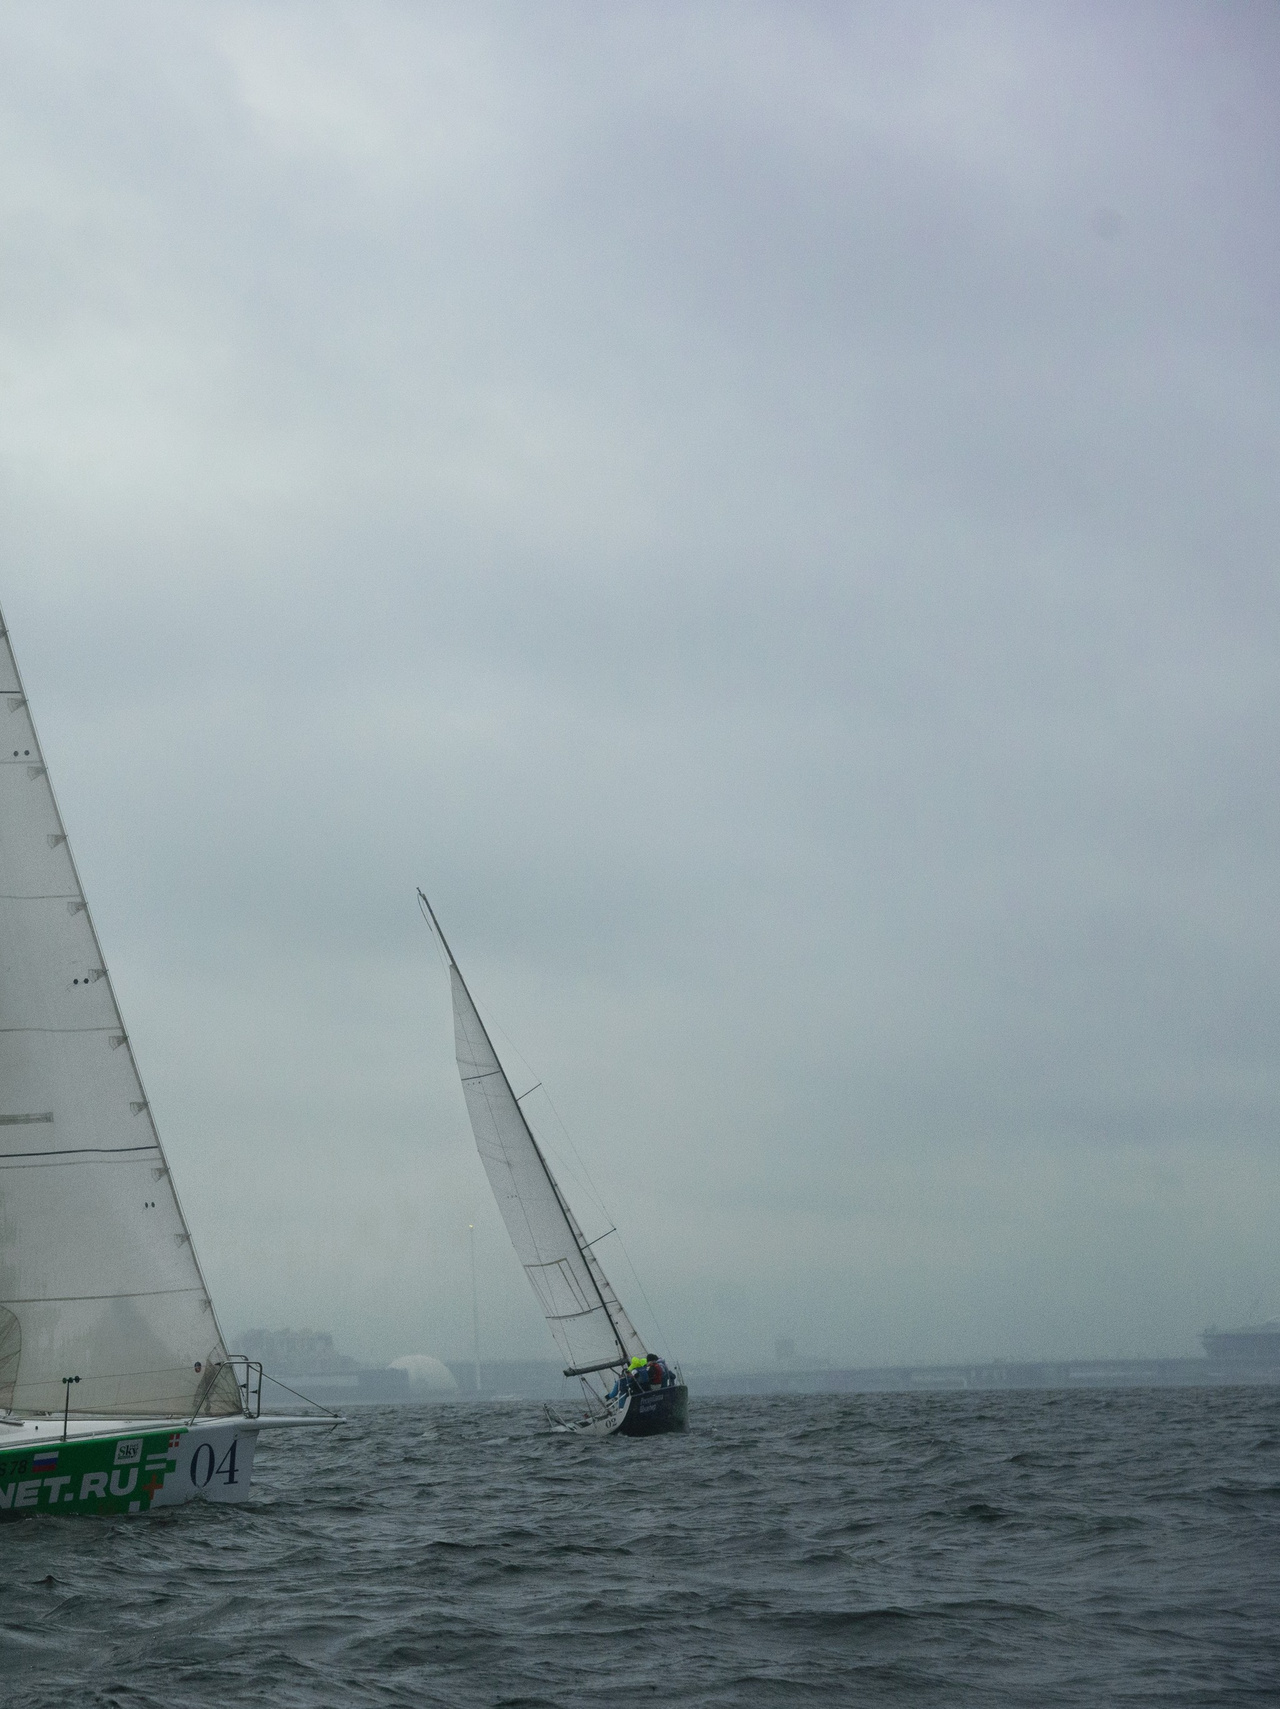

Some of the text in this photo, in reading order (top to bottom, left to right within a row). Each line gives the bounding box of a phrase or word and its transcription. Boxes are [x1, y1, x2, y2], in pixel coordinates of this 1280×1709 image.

[605, 1418, 617, 1428] 02
[119, 1445, 138, 1459] Sky
[9, 1460, 28, 1476] 78
[190, 1439, 239, 1488] 04
